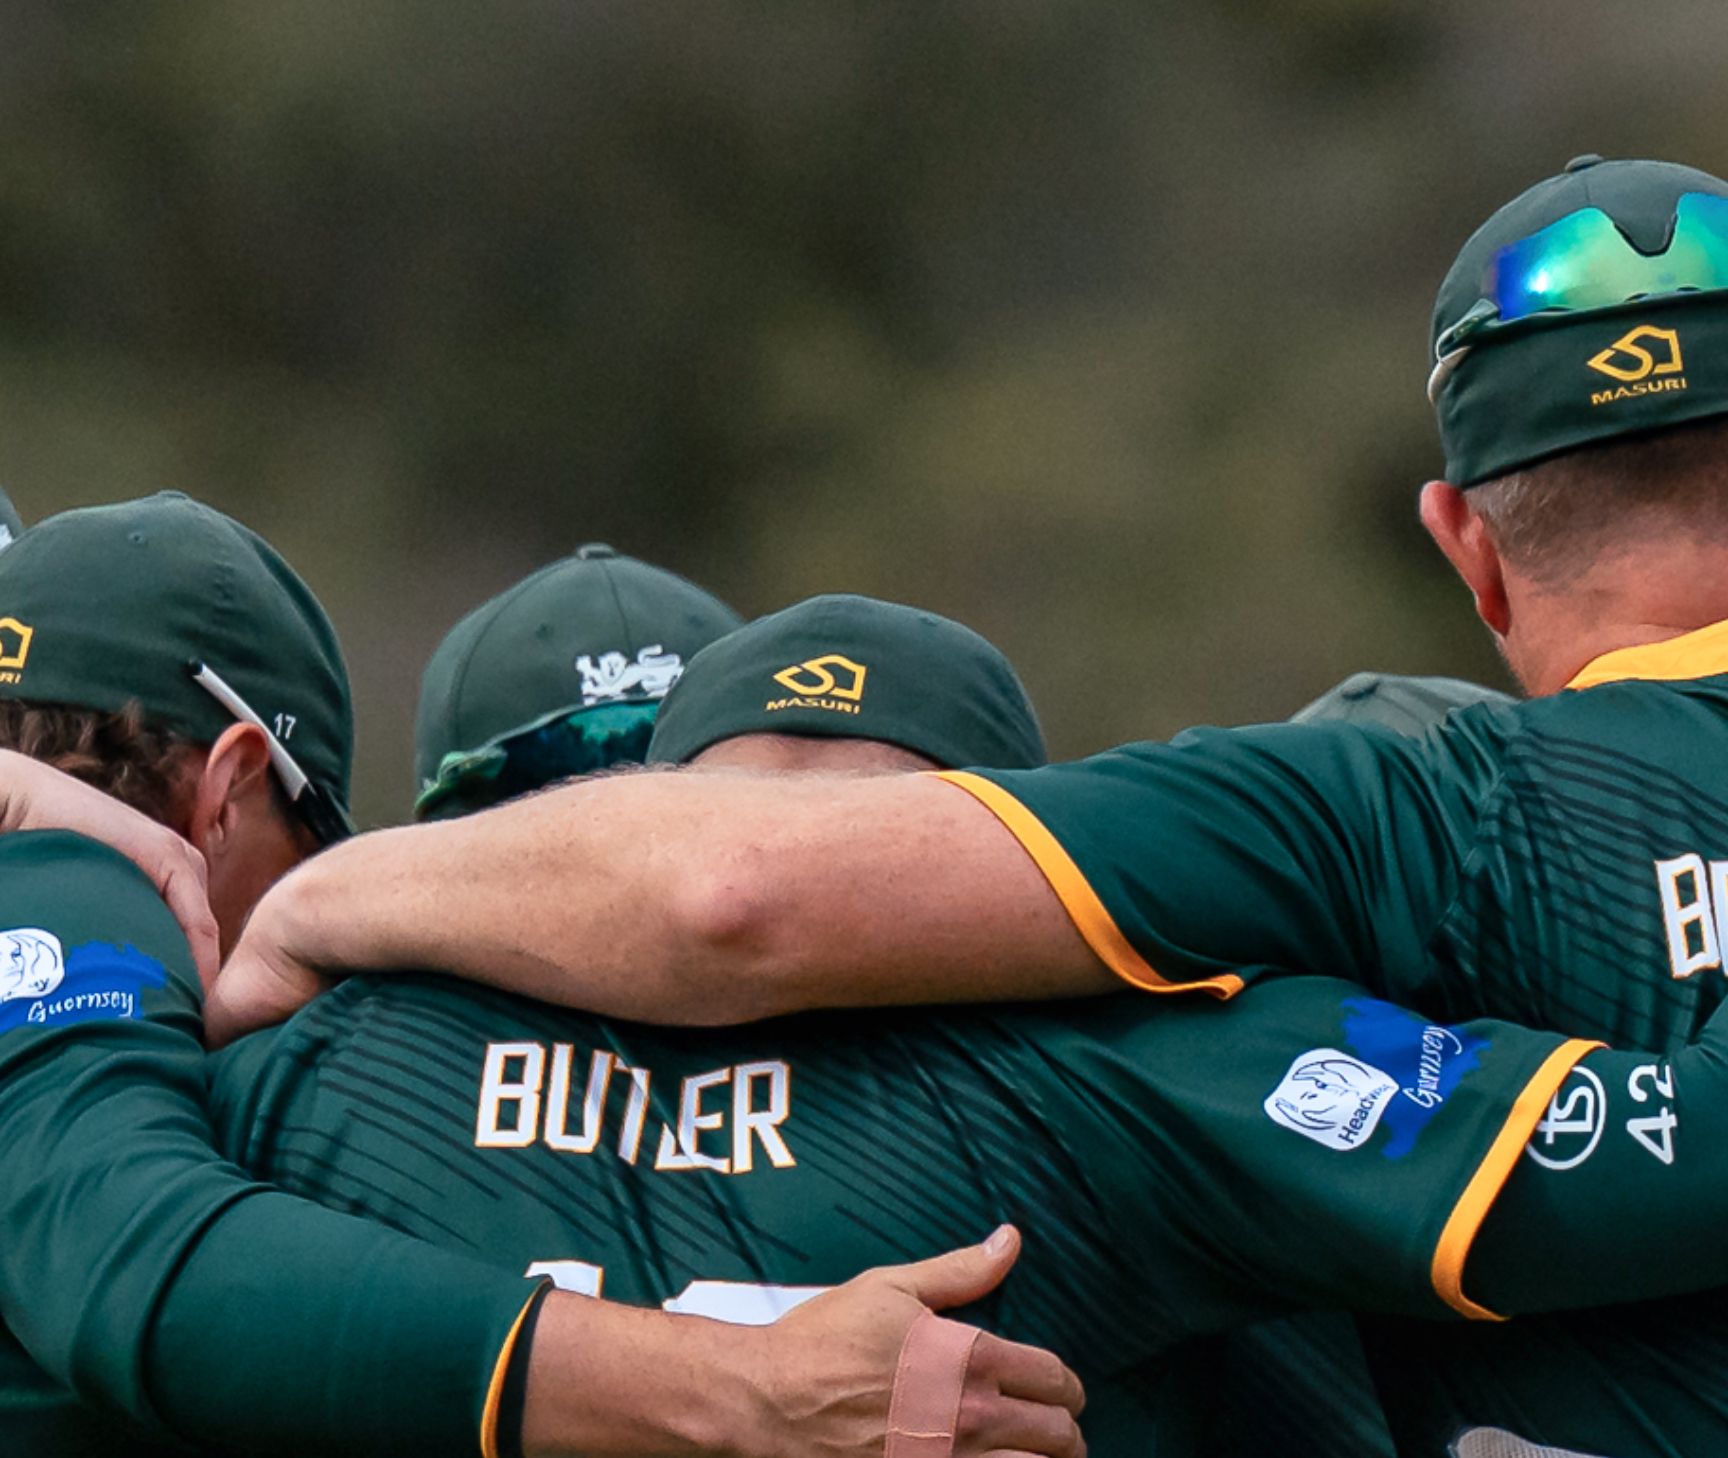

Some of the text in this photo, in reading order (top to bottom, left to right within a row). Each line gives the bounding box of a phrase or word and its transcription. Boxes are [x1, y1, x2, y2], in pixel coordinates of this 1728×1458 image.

[1591, 377, 1688, 406] MASURI
[765, 697, 860, 716] MASURI
[274, 712, 297, 740] 17
[473, 1040, 798, 1175] BUTLER
[1626, 1063, 1678, 1166] 42
